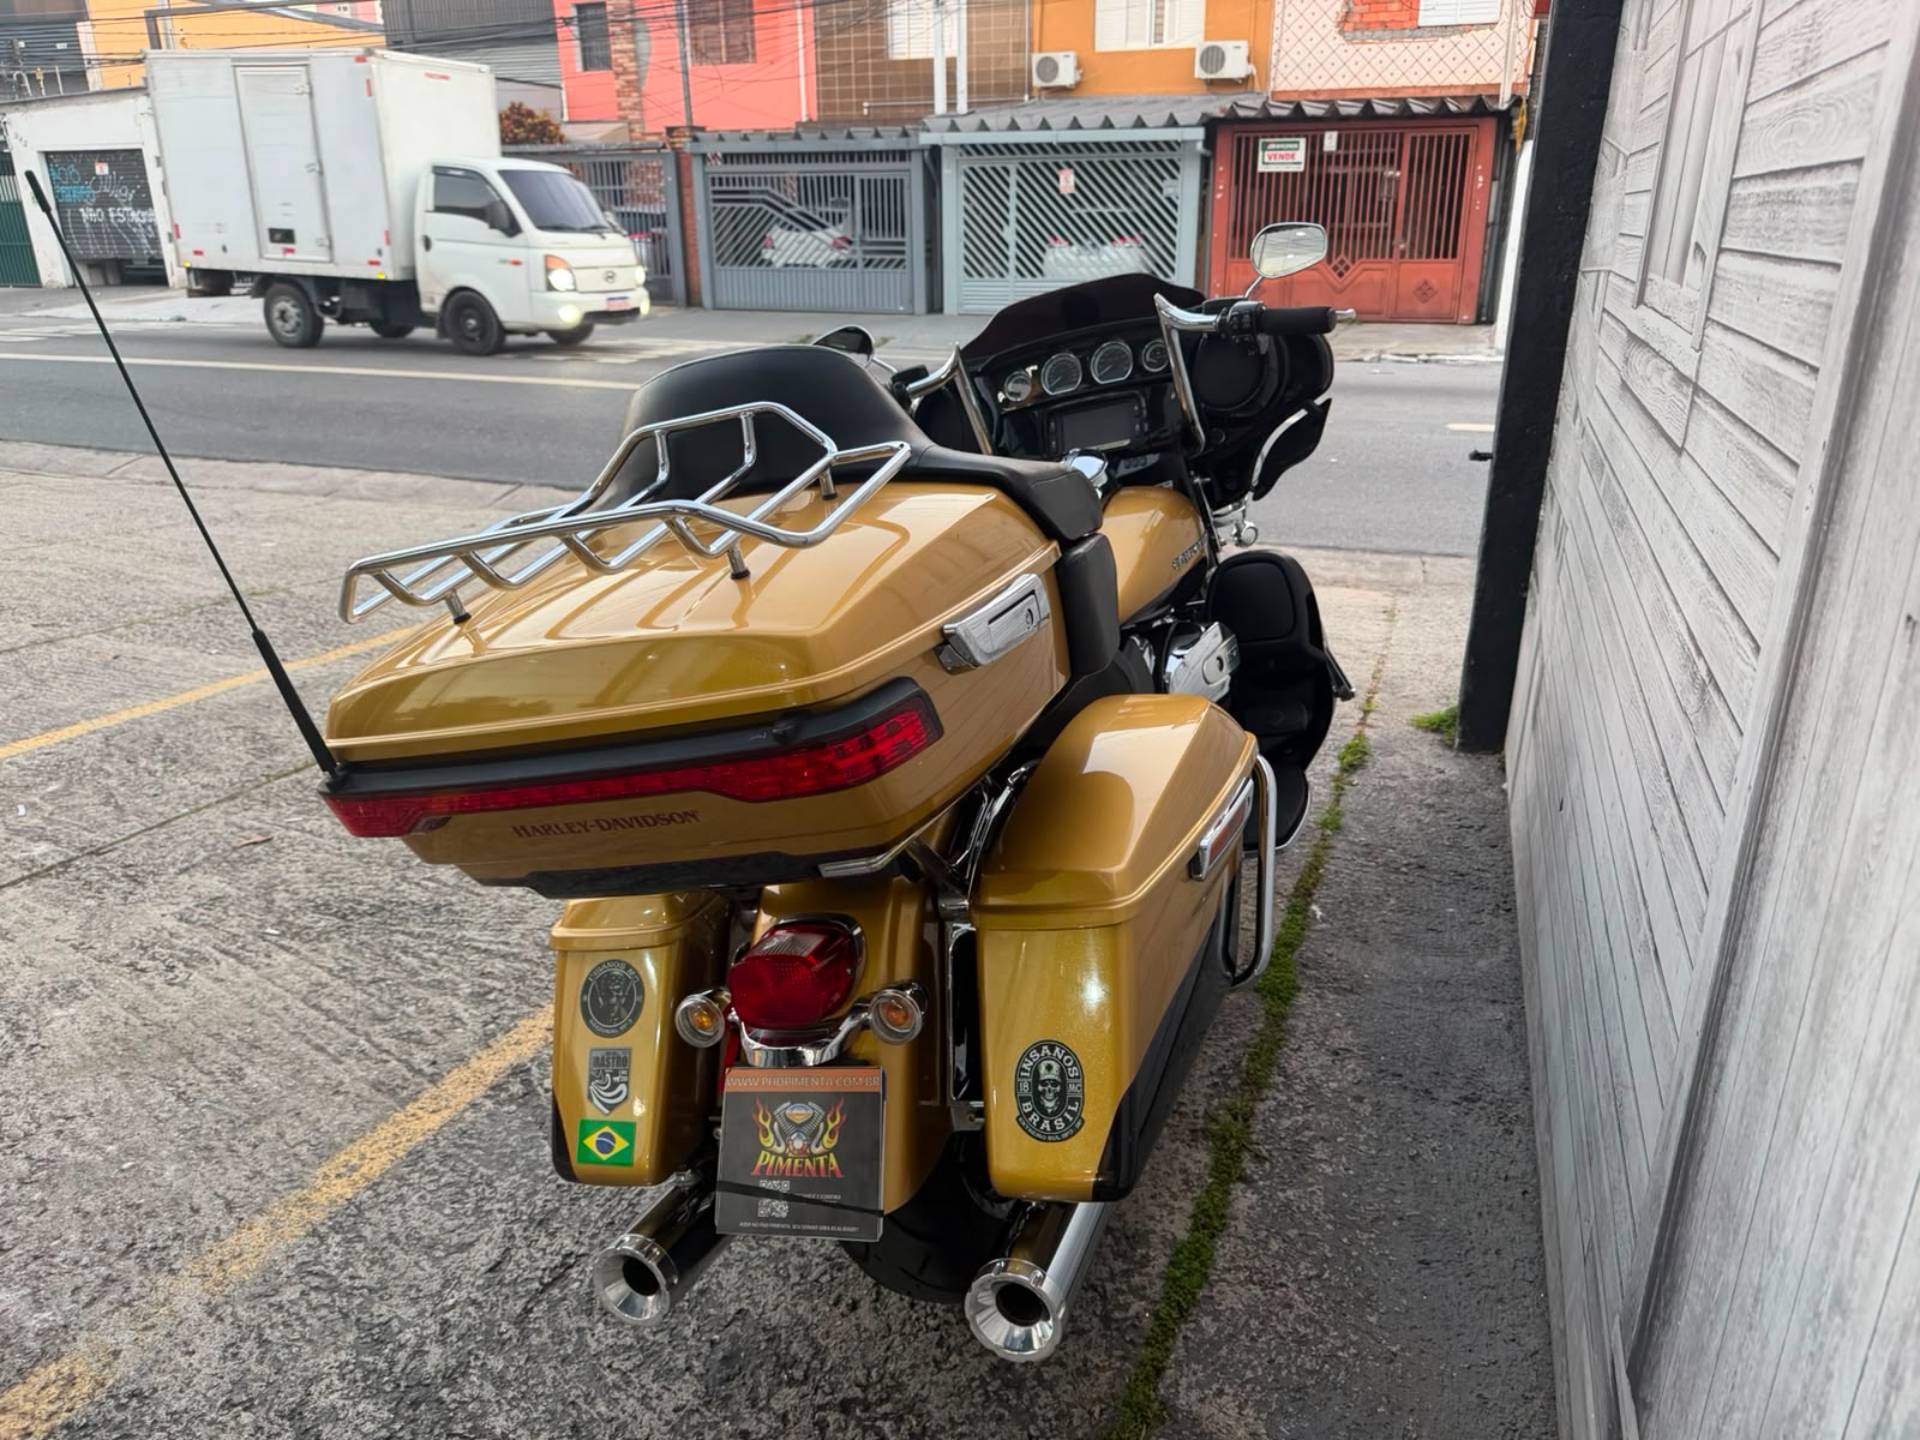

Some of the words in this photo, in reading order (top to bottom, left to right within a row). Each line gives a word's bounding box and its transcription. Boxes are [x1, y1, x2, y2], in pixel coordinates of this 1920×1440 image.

[1266, 152, 1297, 161] VENDE
[511, 810, 701, 838] HARLEY-DAVIDSON
[1020, 1045, 1079, 1077] INSANOS
[1021, 1101, 1079, 1131] BRASIL
[751, 1150, 844, 1179] PIMENTA
